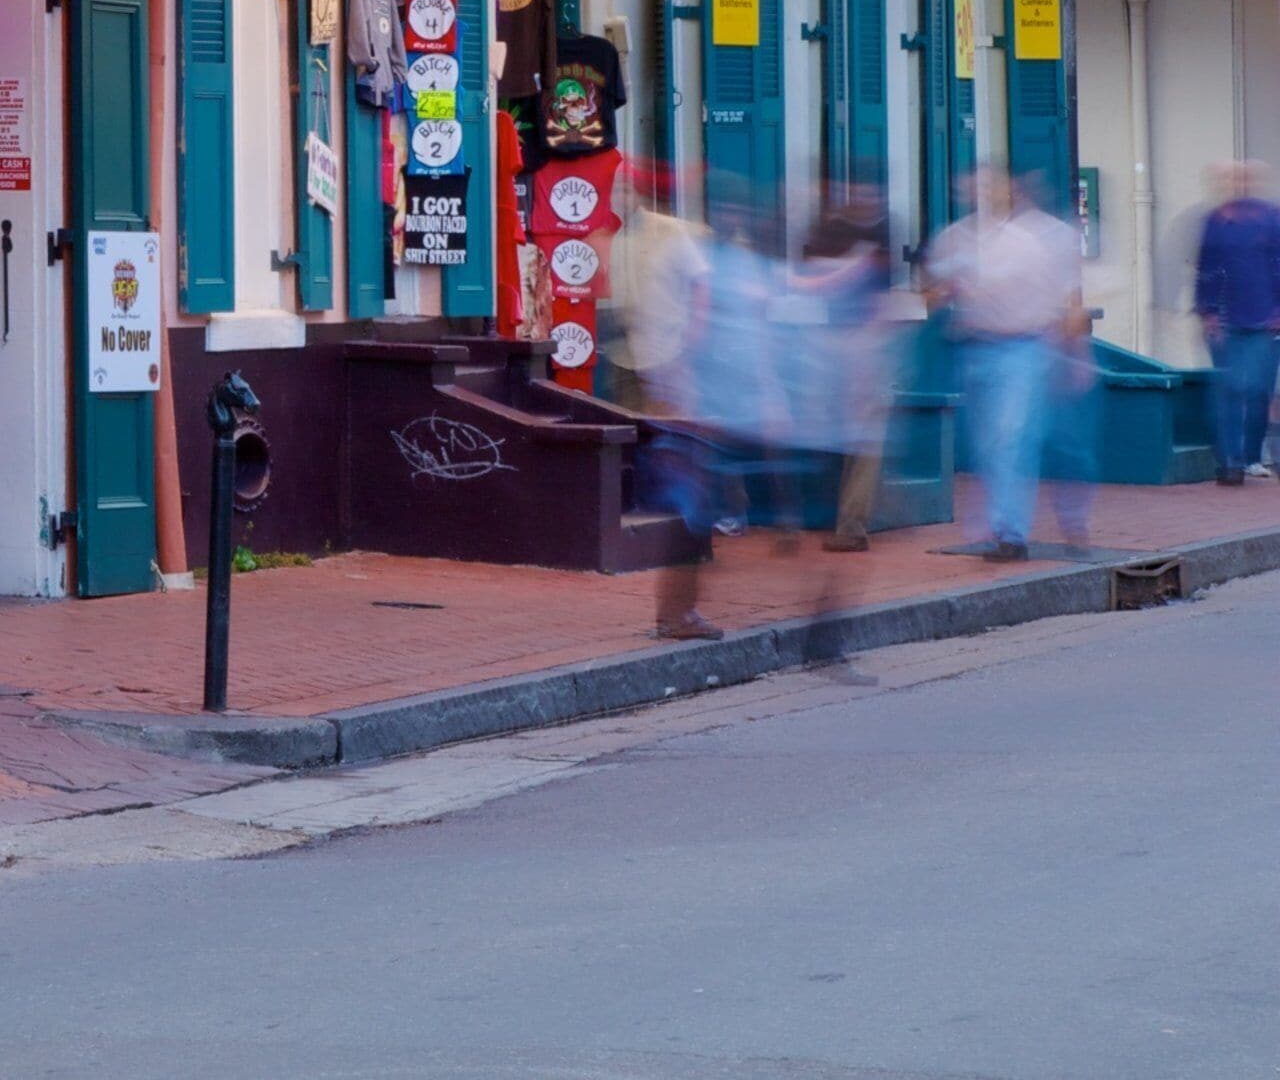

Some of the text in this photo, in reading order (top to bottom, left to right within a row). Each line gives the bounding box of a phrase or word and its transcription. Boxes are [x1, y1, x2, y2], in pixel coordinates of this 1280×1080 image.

[425, 19, 438, 34] 4
[412, 57, 453, 76] BITCH
[430, 142, 442, 159] 2
[552, 180, 597, 203] DRUNK
[411, 196, 462, 216] I GOT
[570, 201, 581, 216] 1
[423, 232, 449, 250] ON
[428, 249, 466, 264] STREET
[553, 240, 599, 267] DRUNK
[570, 263, 582, 279] 2
[101, 325, 152, 353] No Cover
[562, 345, 576, 361] 3
